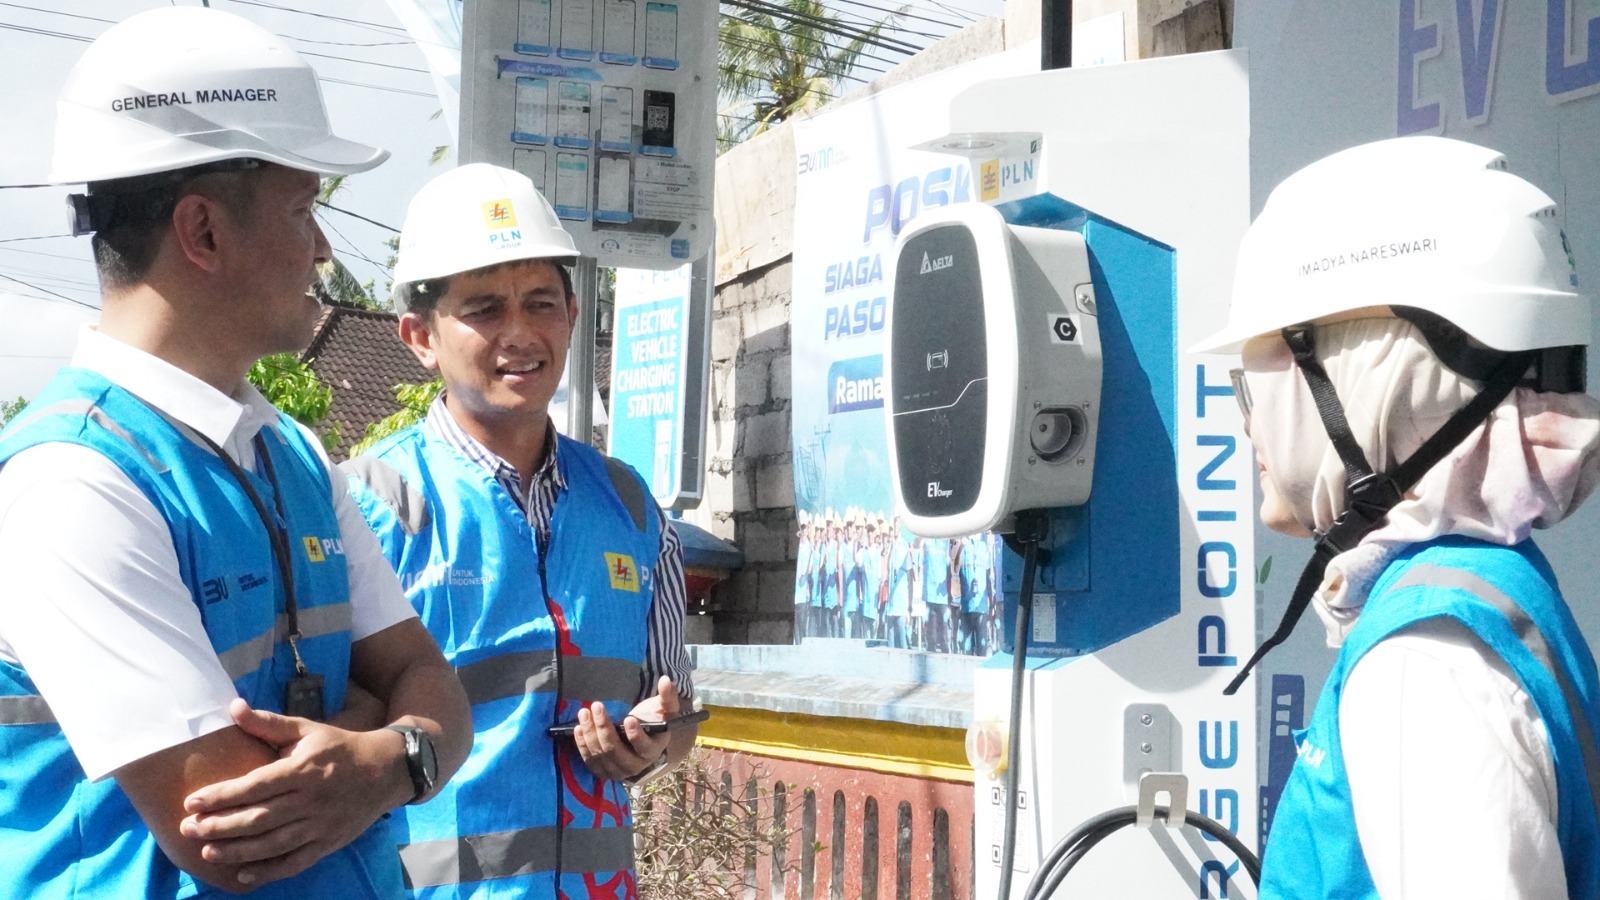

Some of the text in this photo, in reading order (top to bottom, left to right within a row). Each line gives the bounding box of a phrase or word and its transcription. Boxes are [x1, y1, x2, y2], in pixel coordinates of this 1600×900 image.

[1397, 0, 1498, 136] EV
[111, 88, 277, 112] GENERAL MANAGER
[1001, 158, 1034, 187] PLN
[489, 229, 522, 244] PLN
[1350, 238, 1437, 264] NARESWARI
[825, 253, 883, 293] SIAGA
[932, 254, 954, 271] DELTA
[627, 305, 679, 337] ELECTRIC
[825, 297, 887, 340] PASO
[1059, 322, 1072, 337] C
[631, 334, 678, 364] VEHICLE
[616, 363, 675, 392] CHARGING
[836, 374, 884, 405] Rama
[627, 392, 674, 419] STATION
[1196, 364, 1238, 667] POINT
[452, 569, 475, 578] UNTUK
[1299, 739, 1327, 769] PLN
